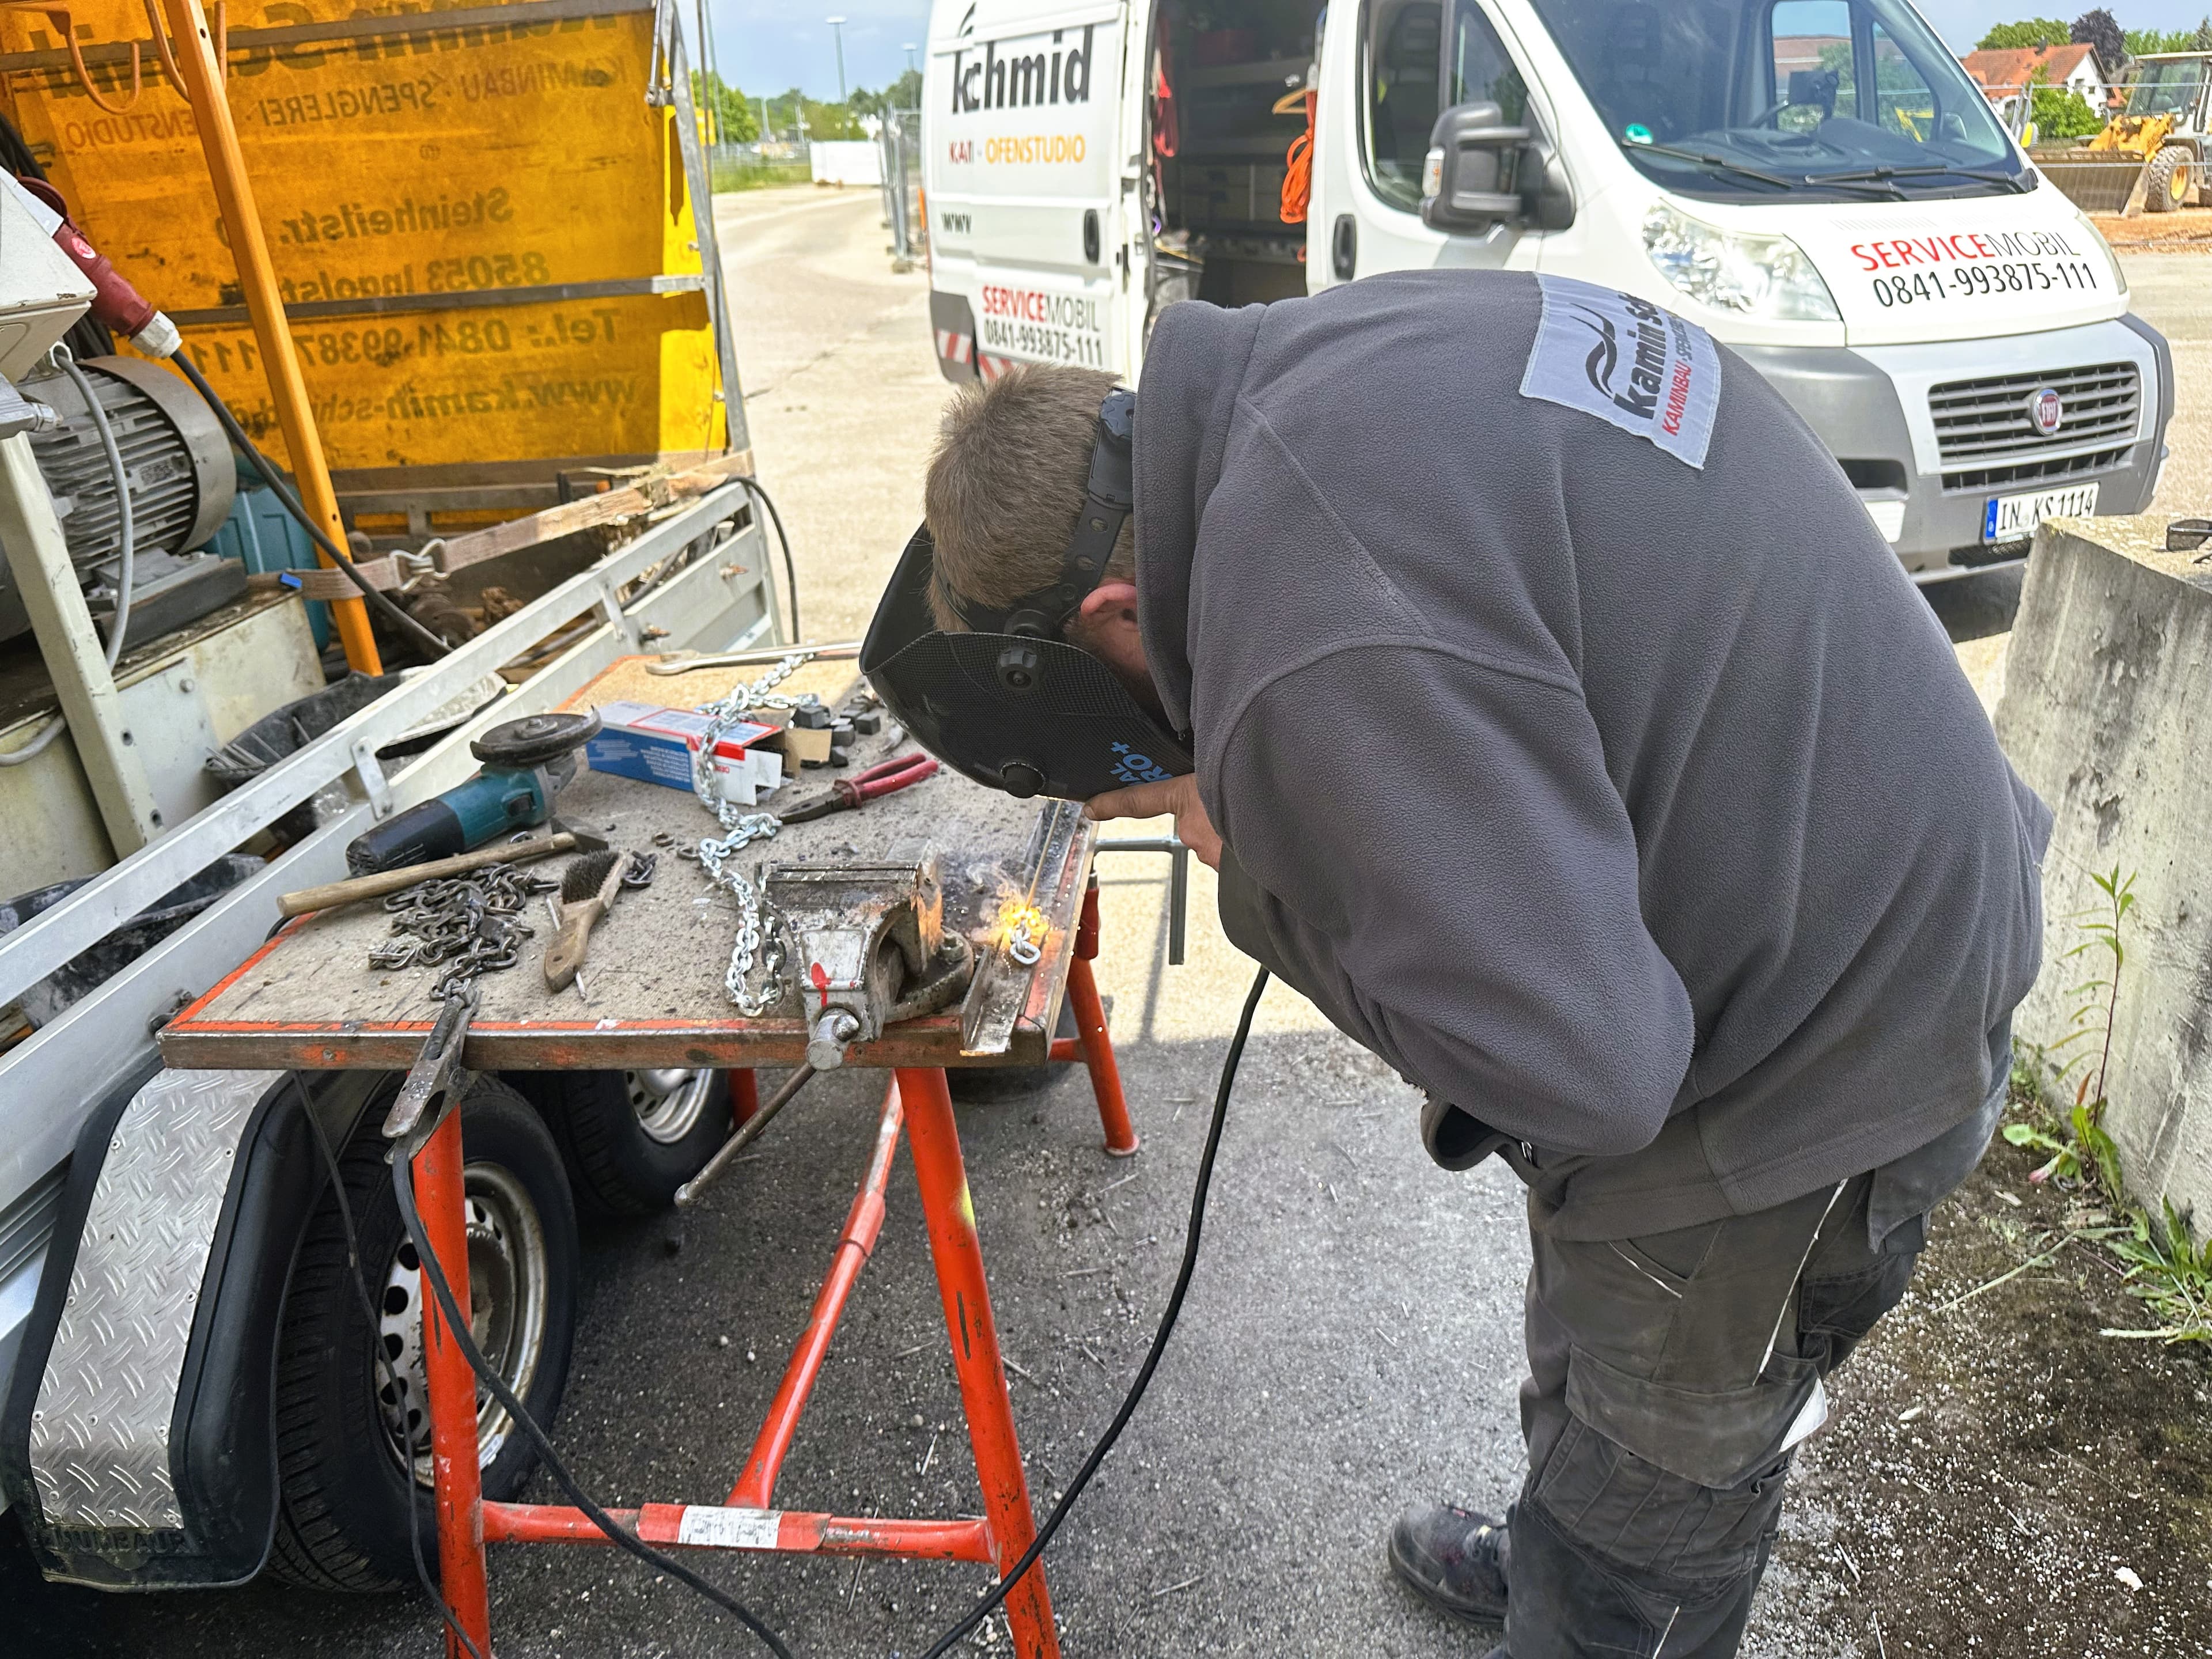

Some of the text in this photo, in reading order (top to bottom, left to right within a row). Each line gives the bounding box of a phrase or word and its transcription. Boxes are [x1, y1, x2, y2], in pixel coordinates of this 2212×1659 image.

[985, 134, 1086, 164] OFENSTUDIO
[1851, 232, 2081, 271] SERVICEMOBIL
[1873, 263, 2097, 307] 0841-993875-111
[982, 285, 1100, 332] SERVICEMOBIL
[984, 319, 1103, 367] 0841-993875-111
[1662, 360, 1692, 436] KAMINBAU
[1999, 501, 2021, 531] IN
